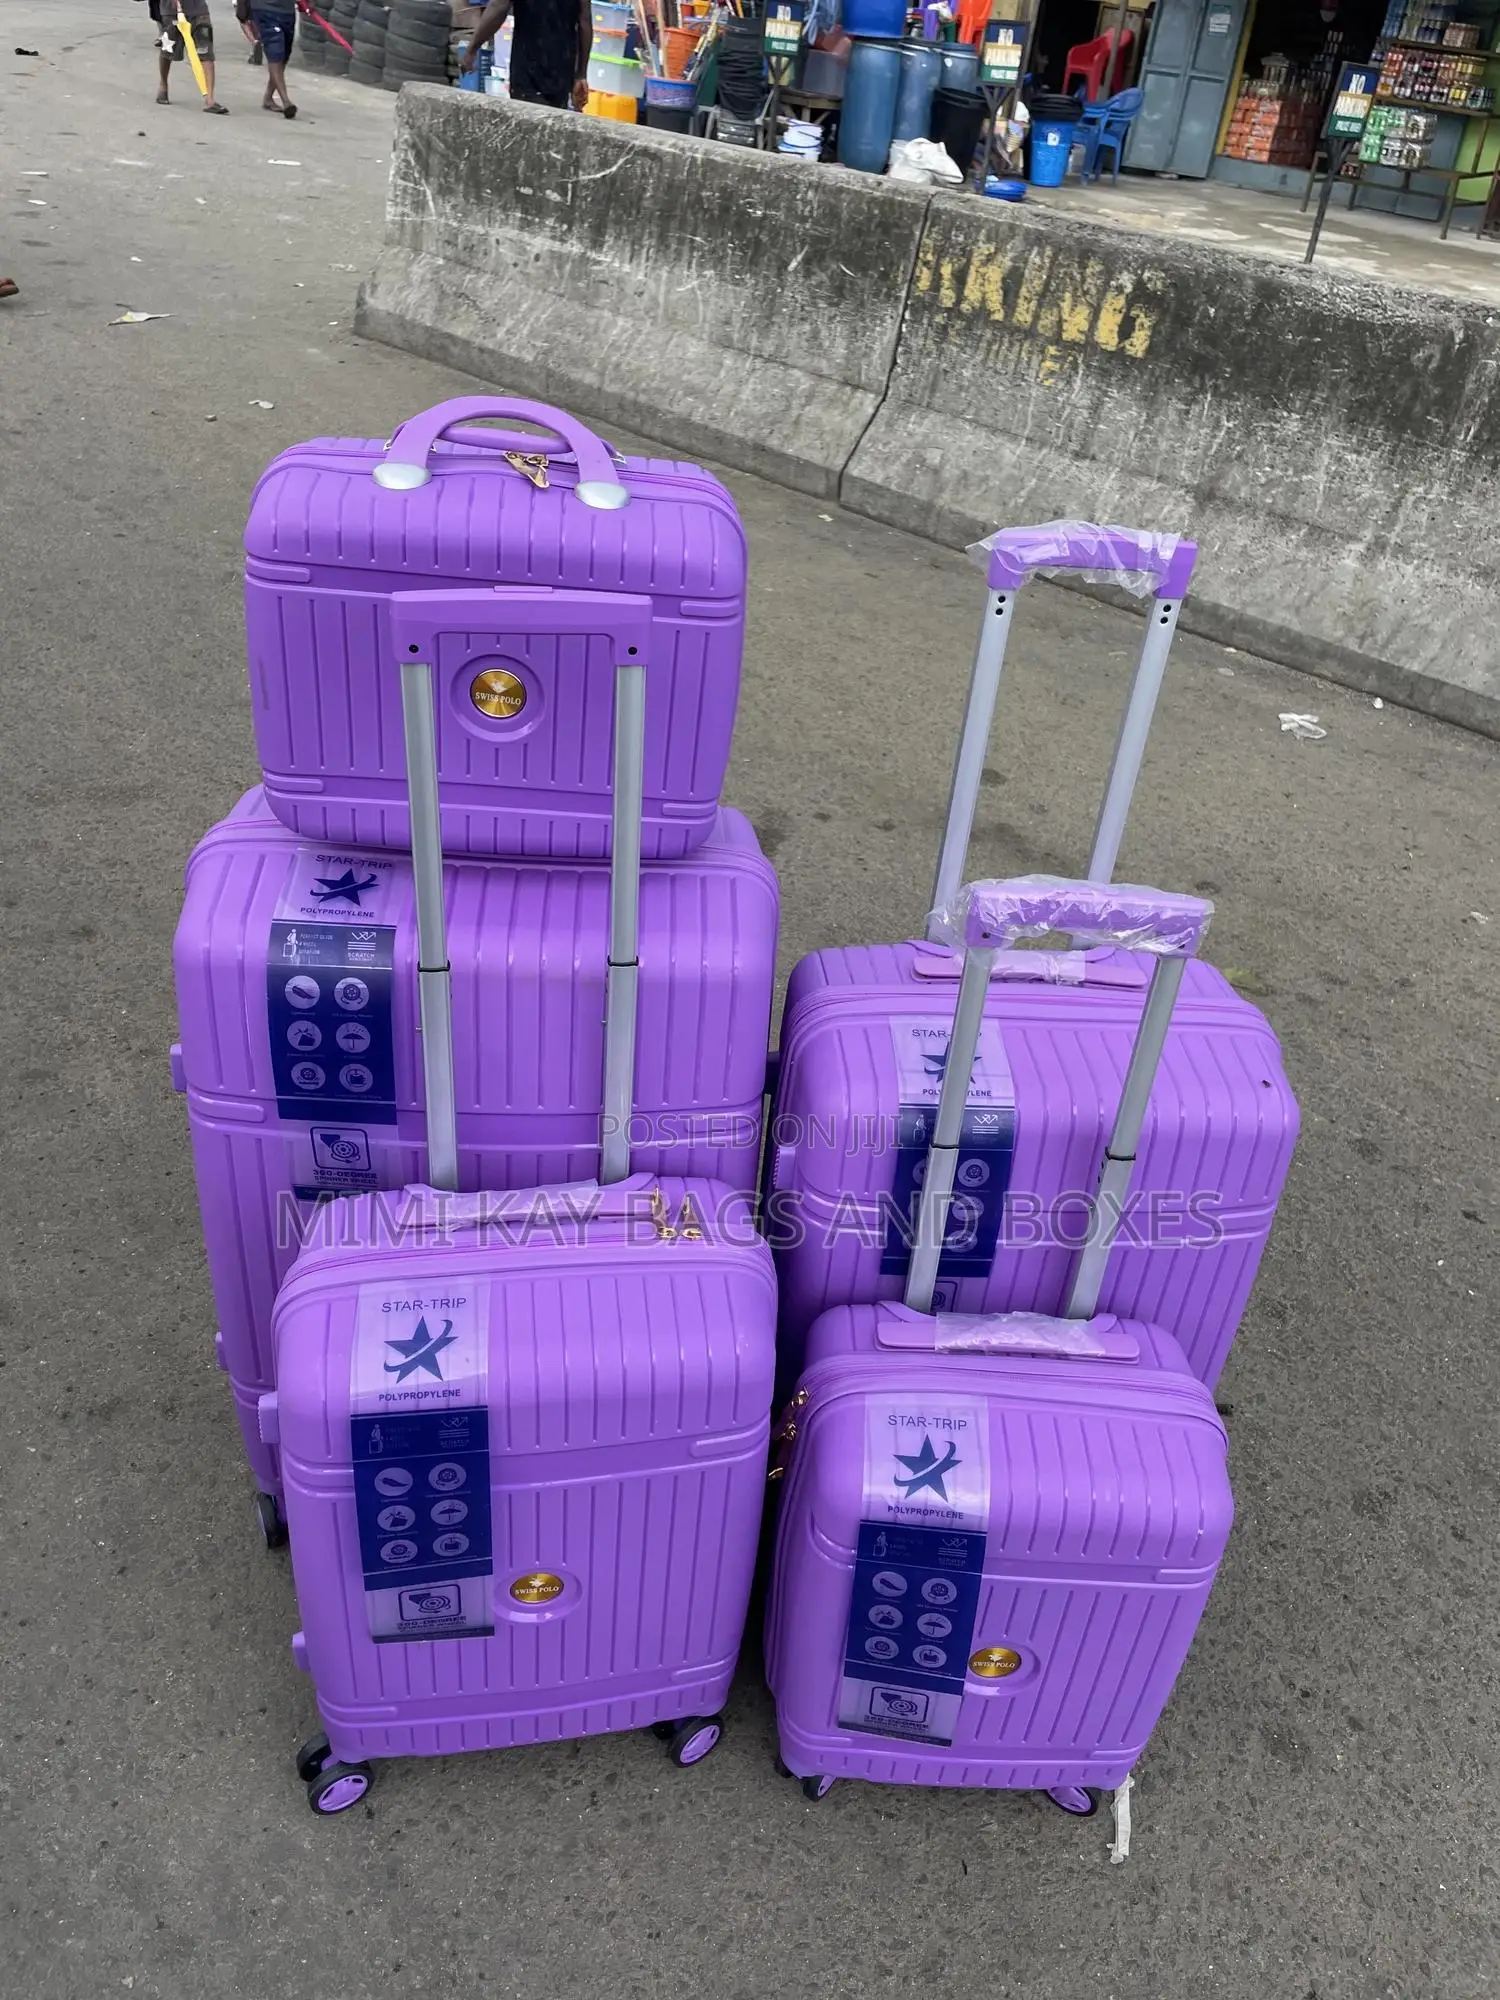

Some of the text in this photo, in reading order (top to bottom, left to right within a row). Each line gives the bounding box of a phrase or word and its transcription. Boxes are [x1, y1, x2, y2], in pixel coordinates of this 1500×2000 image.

[475, 692, 522, 705] SWISS POLO
[315, 854, 393, 870] STAR-TRIP
[300, 907, 375, 918] POLYPROPYLENE
[381, 1297, 467, 1313] STAR-TRIP
[379, 1389, 461, 1402] POLYPROPYLENE
[887, 1414, 967, 1431] STAR-TRIP
[887, 1505, 964, 1520] POLYPROPYLENE
